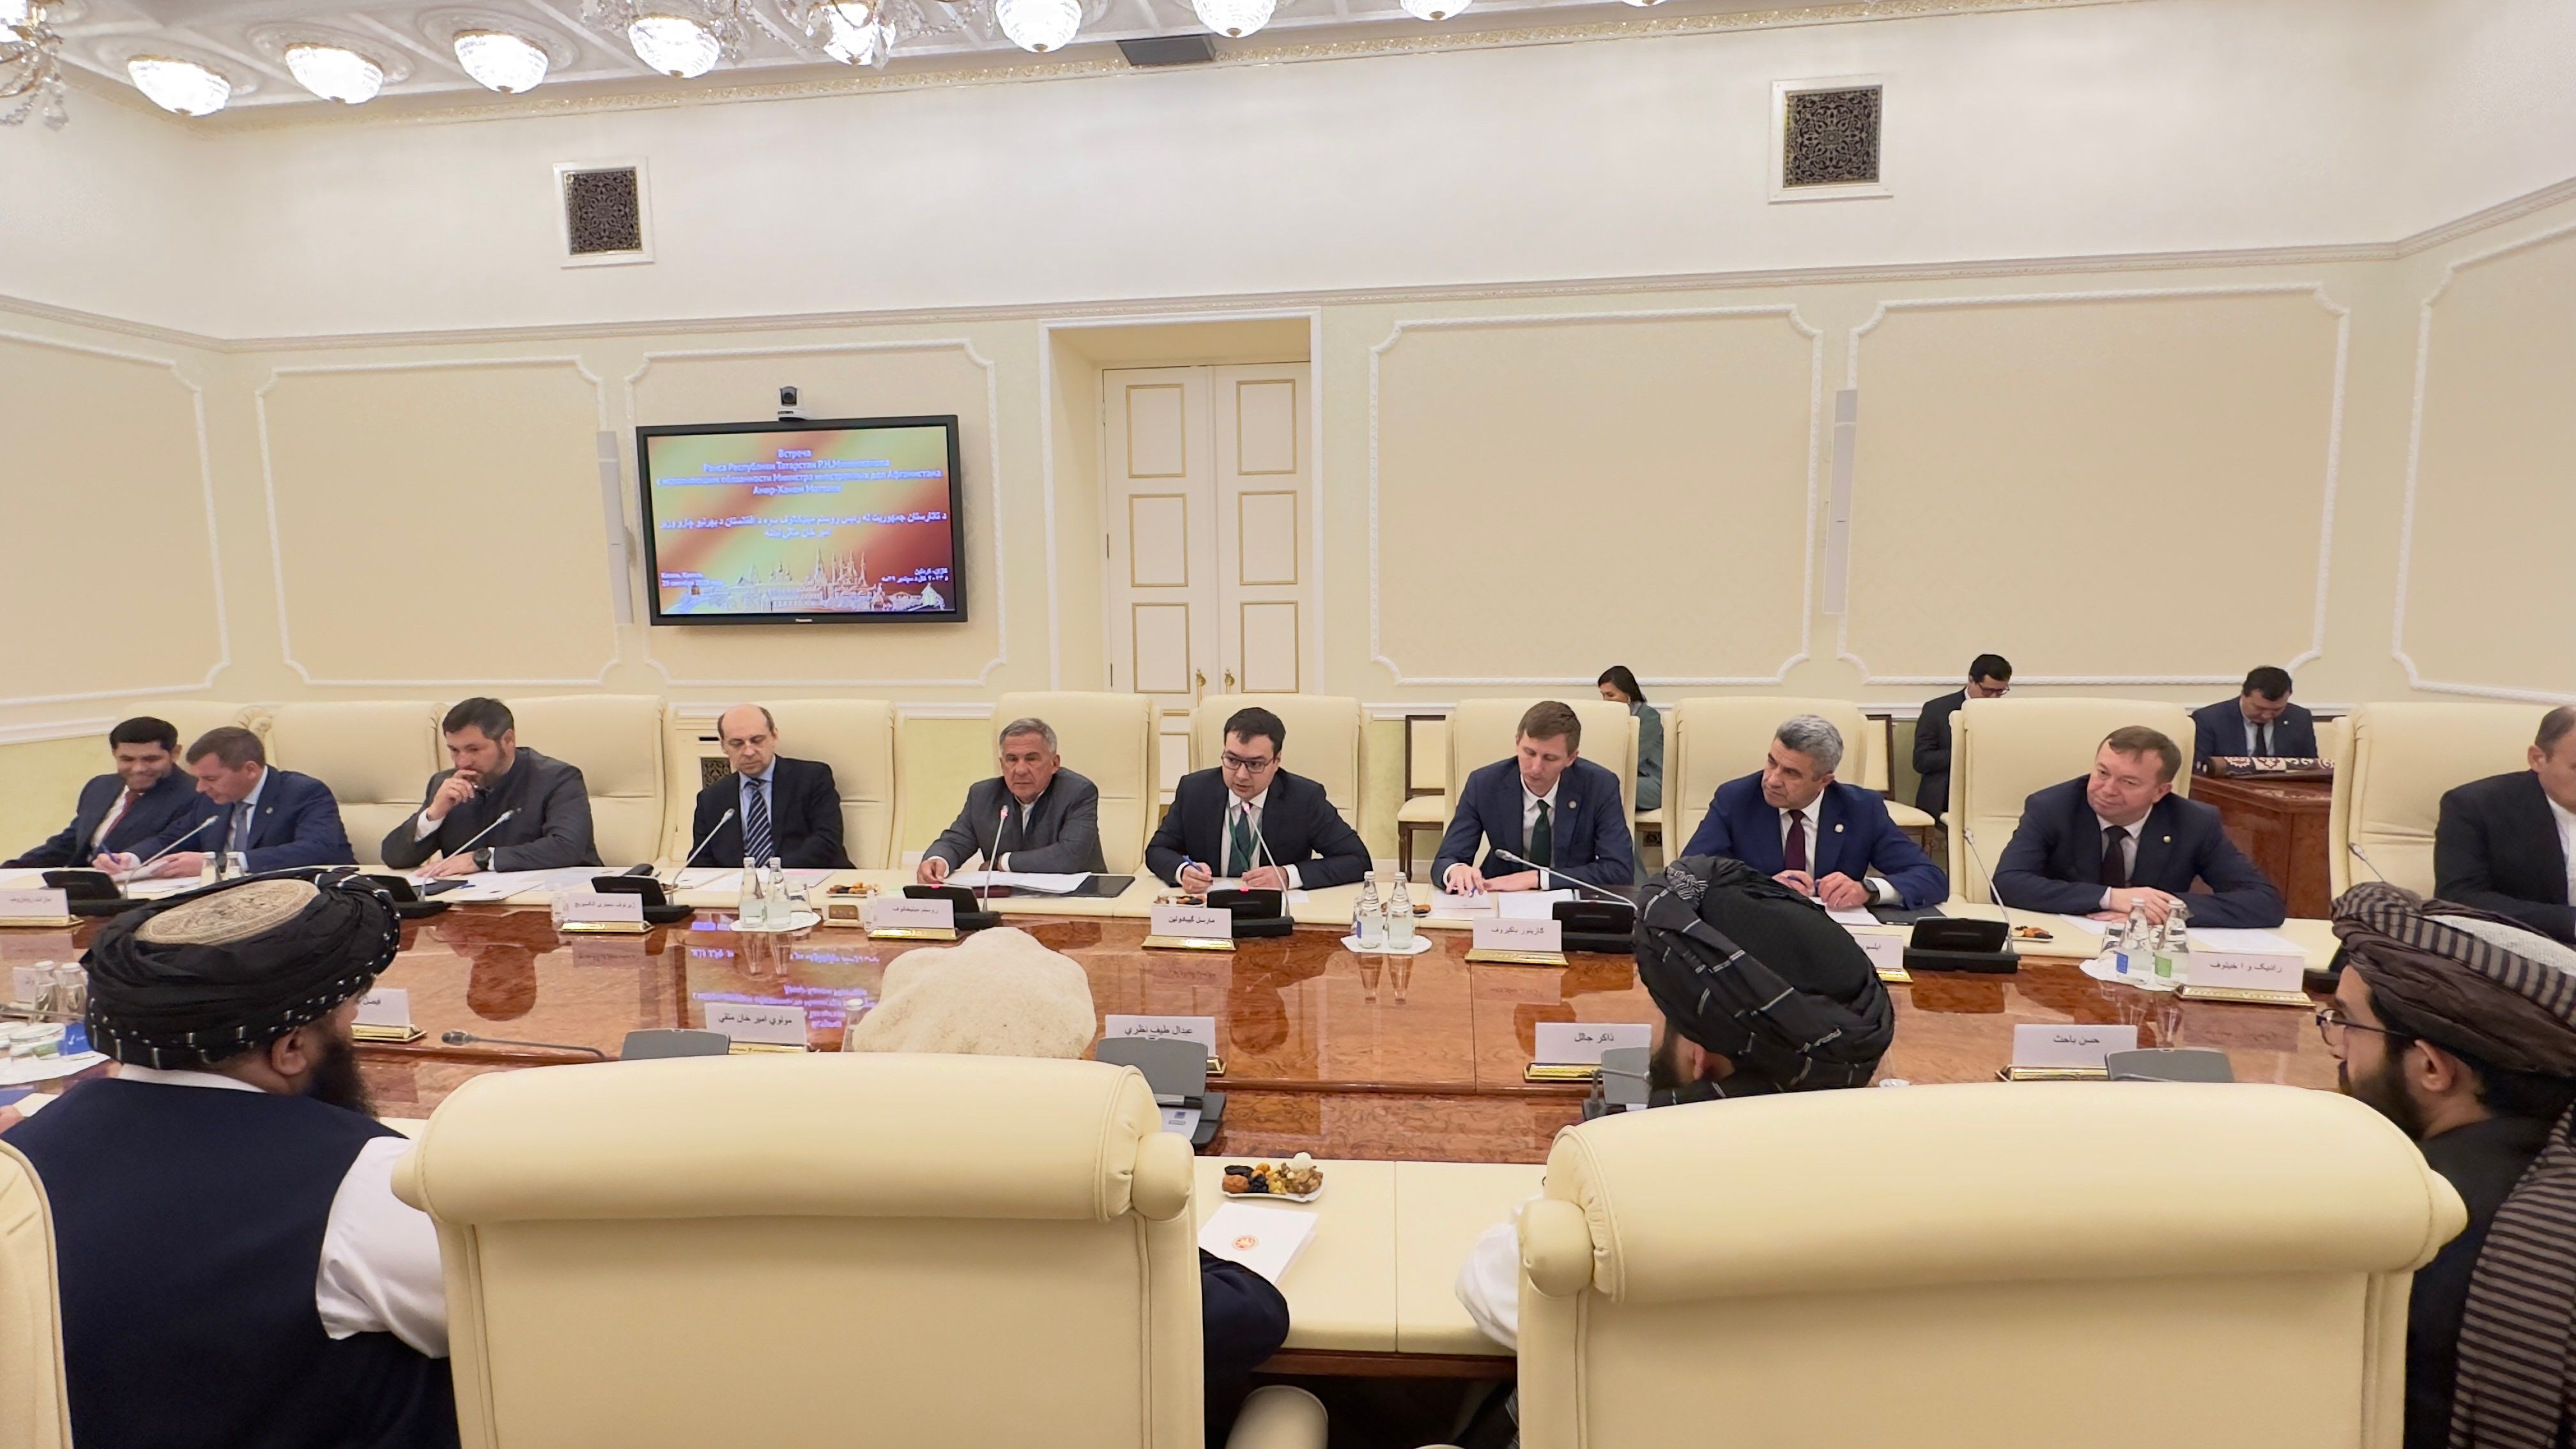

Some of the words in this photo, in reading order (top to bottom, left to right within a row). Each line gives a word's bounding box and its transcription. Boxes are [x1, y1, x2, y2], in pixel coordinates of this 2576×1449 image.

[778, 449, 811, 459] Встреча
[2053, 1034, 2076, 1045] باحث
[2078, 1036, 2101, 1046] حسن
